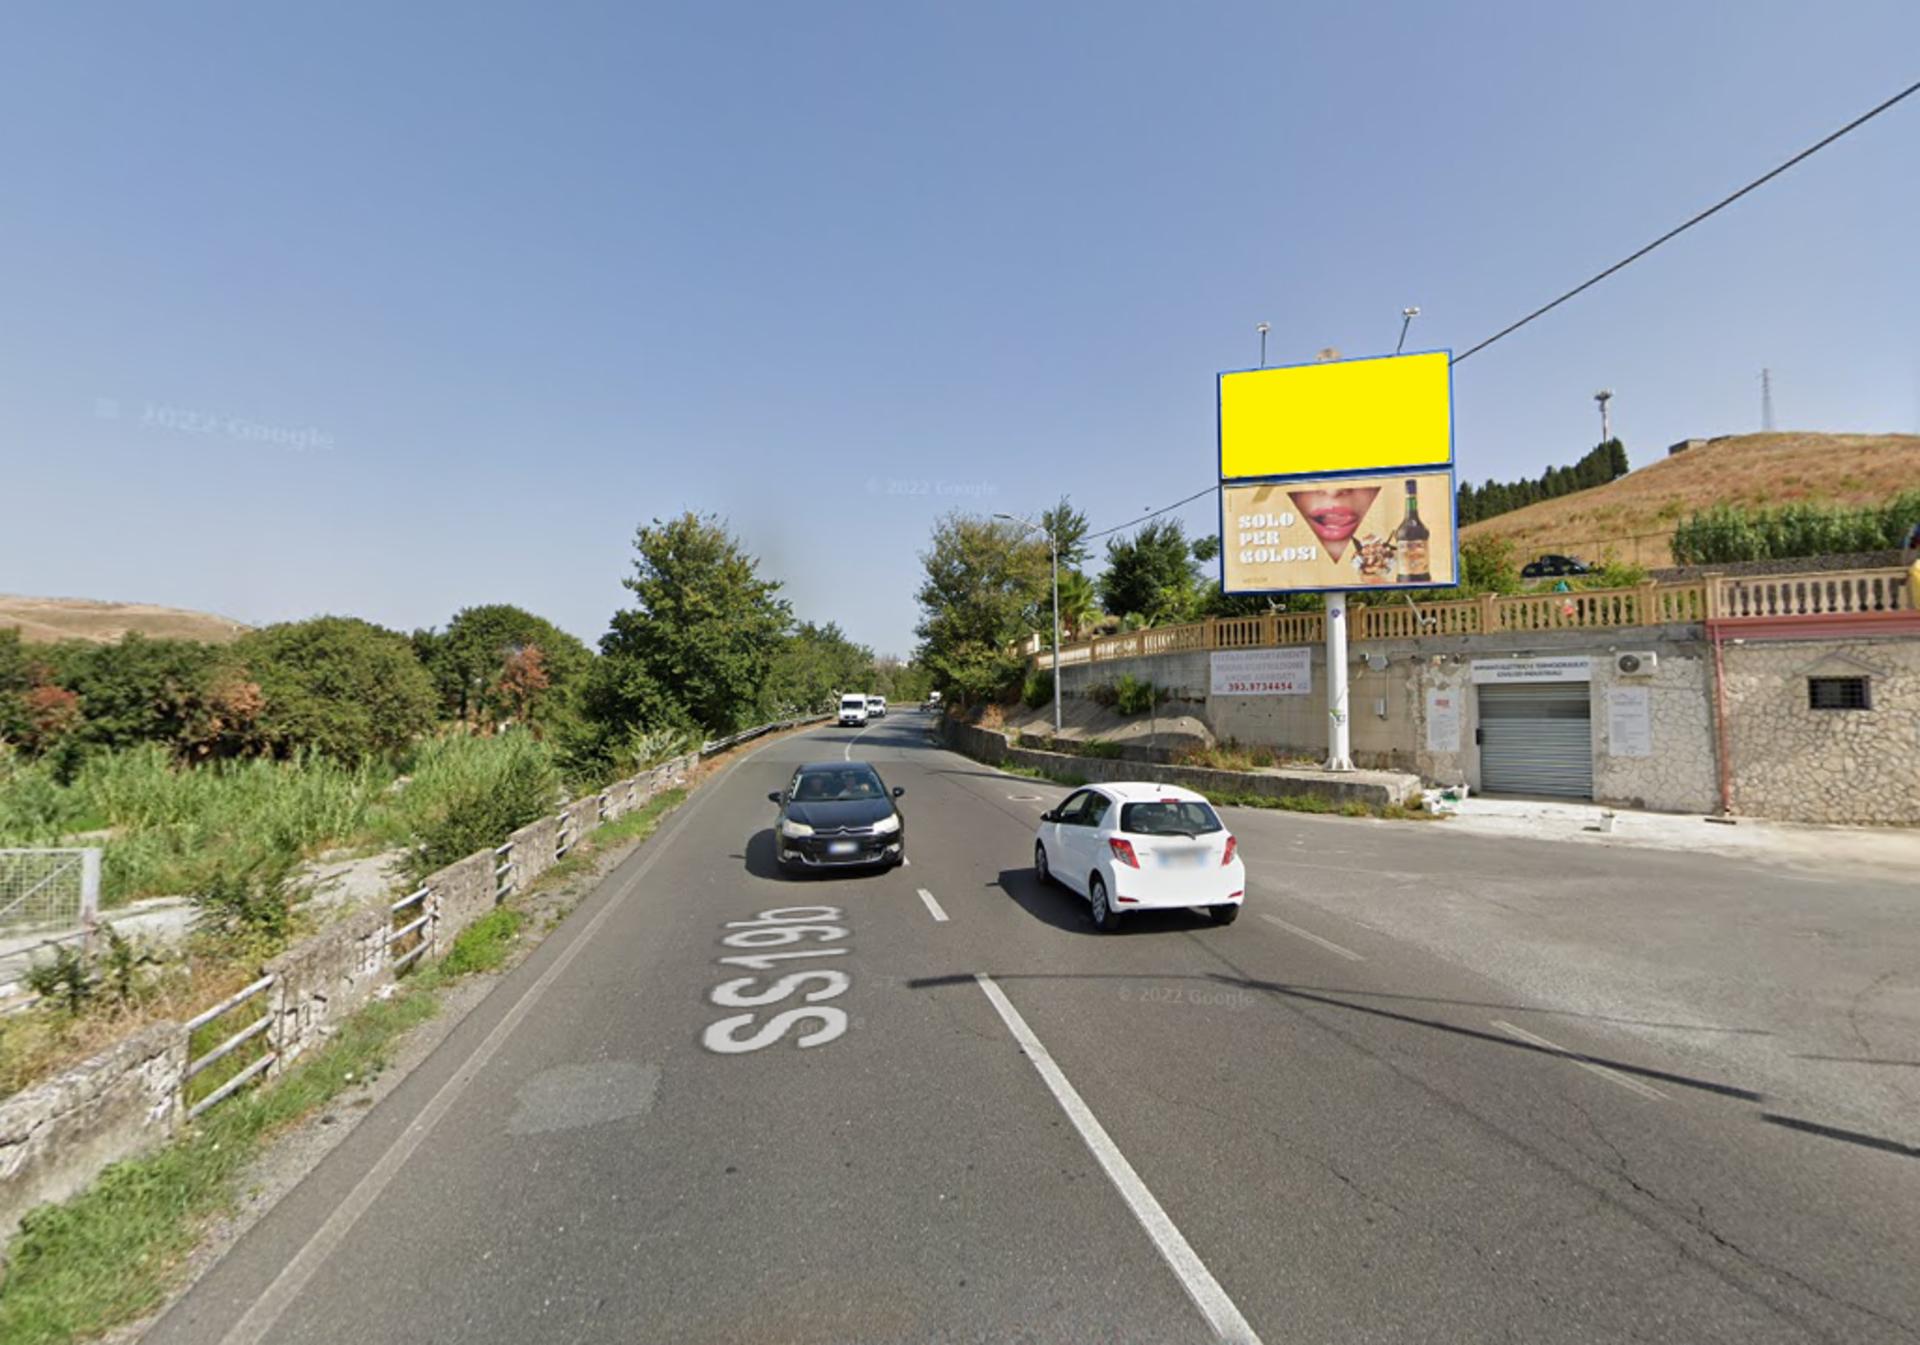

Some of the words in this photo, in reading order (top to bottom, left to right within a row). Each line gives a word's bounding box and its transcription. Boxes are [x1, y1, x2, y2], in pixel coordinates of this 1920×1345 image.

[1238, 512, 1295, 529] SOLO
[1239, 531, 1281, 547] PER
[1240, 545, 1318, 564] GOLOSI
